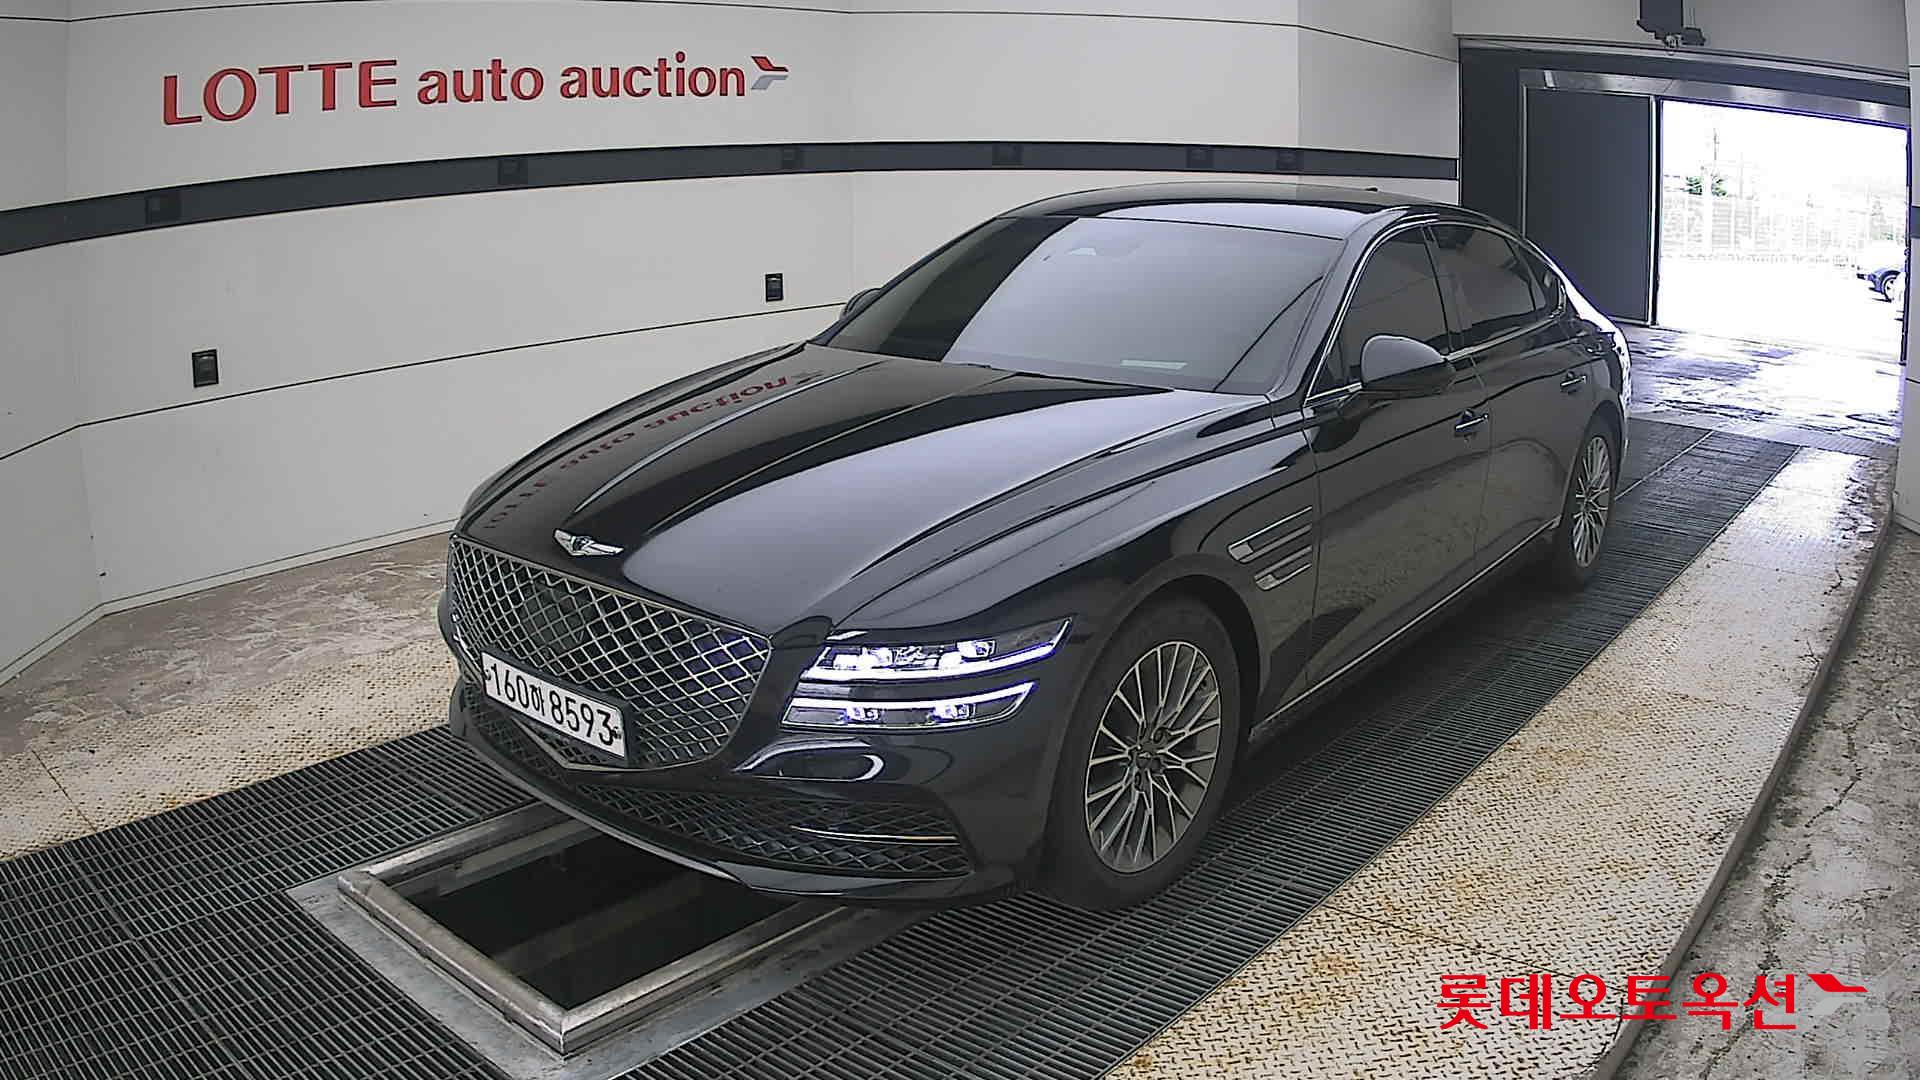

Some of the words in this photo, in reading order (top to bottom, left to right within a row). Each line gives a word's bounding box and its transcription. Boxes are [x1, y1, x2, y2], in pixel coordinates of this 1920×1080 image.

[164, 60, 396, 125] LOTTE
[418, 59, 543, 104] auto
[561, 52, 745, 98] auction
[549, 690, 614, 746] 8593
